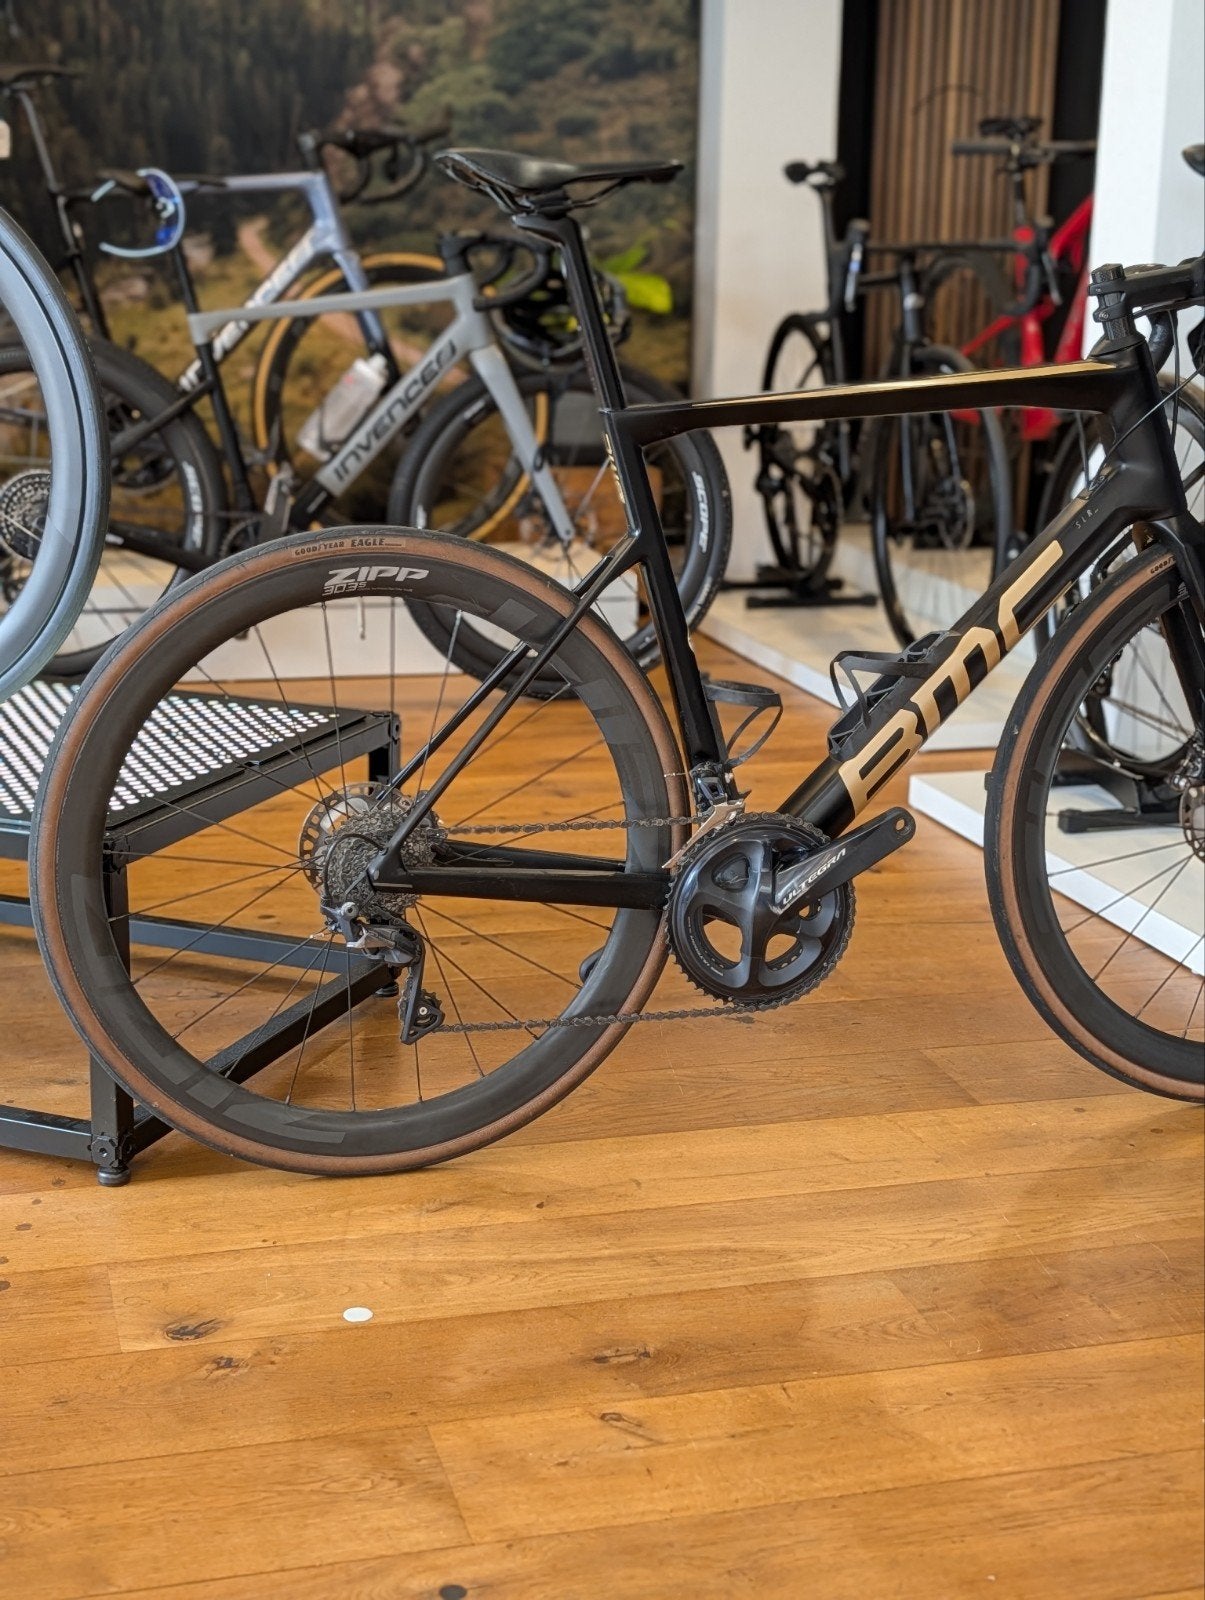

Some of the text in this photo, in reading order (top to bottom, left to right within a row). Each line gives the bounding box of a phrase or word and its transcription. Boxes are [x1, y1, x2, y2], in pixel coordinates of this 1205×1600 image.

[294, 538, 385, 557] GOODYEAR EAGLE
[324, 565, 430, 587] ZIPP
[838, 540, 1064, 817] BMC
[782, 847, 847, 905] ULTEGRA
